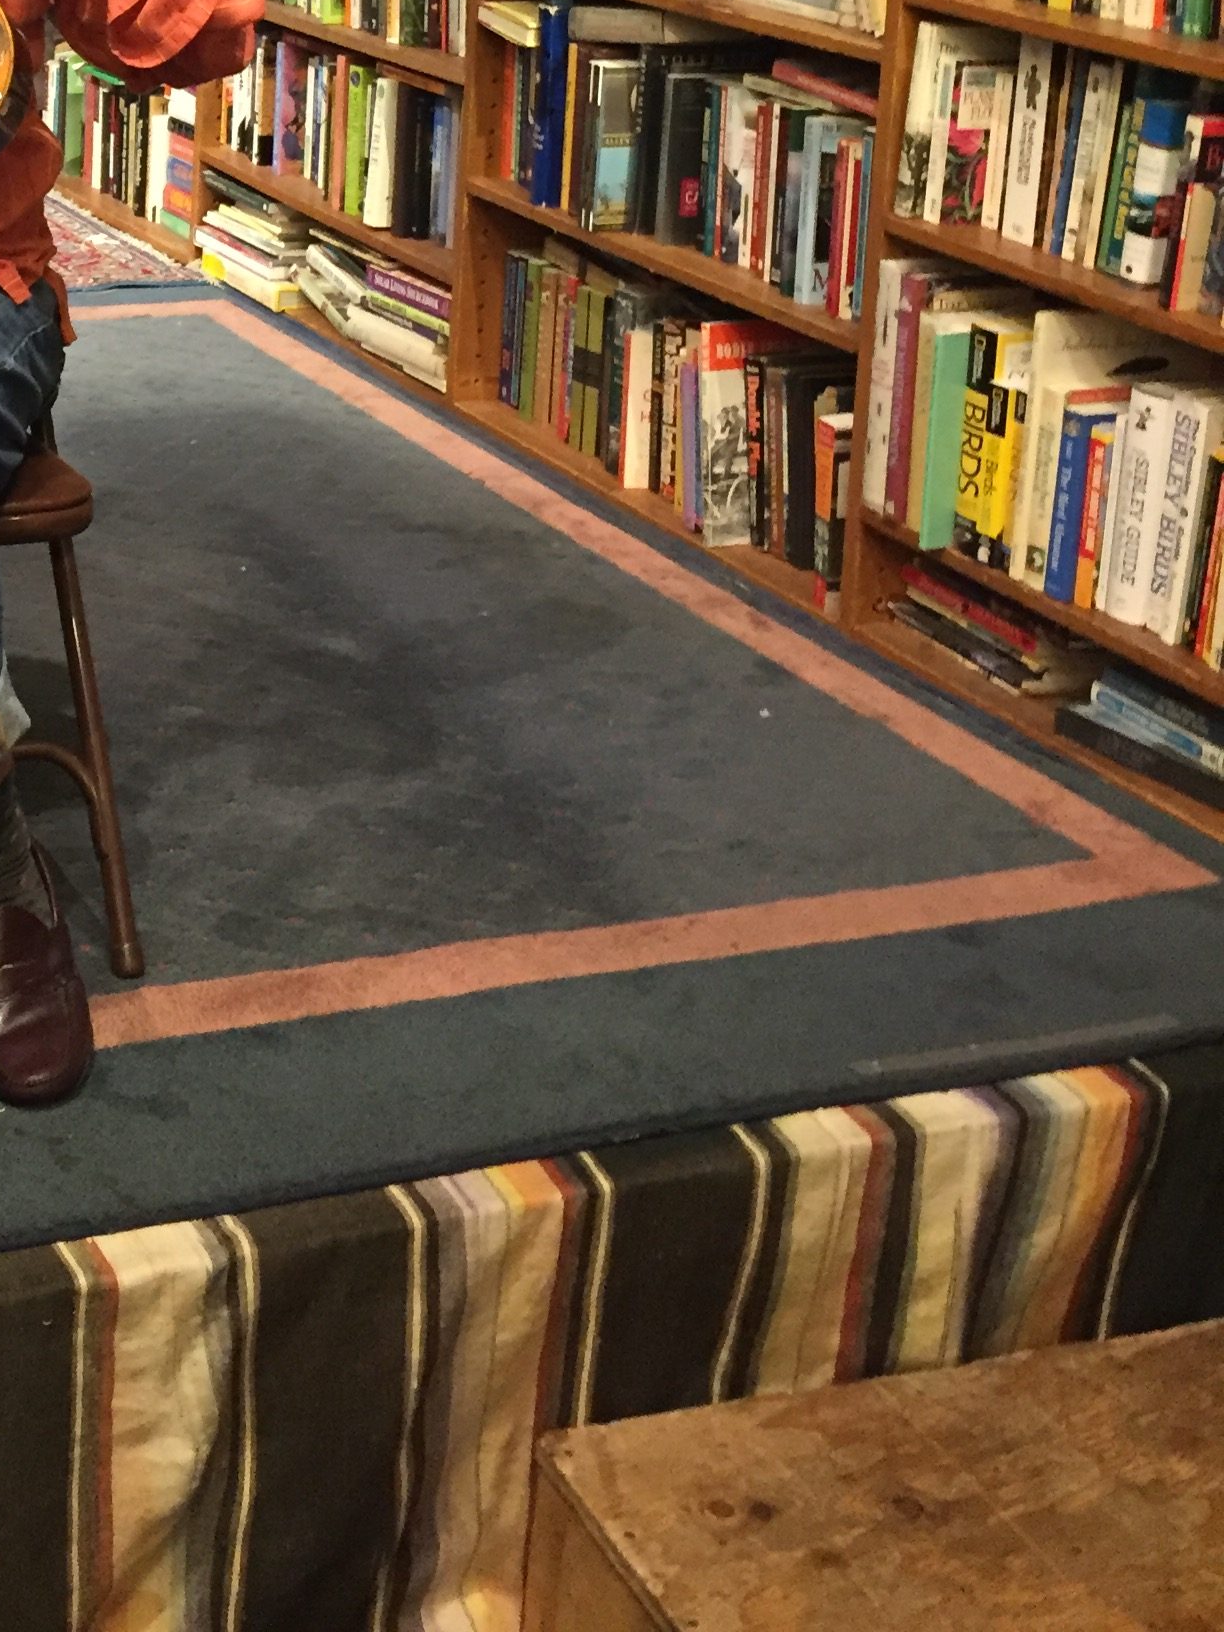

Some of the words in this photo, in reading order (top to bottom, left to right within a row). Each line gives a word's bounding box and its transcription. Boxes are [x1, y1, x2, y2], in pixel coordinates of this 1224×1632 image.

[959, 401, 987, 498] BIRDS
[1129, 456, 1151, 522] SIBLEY
[1164, 410, 1192, 506] SIBLEY
[1120, 524, 1144, 588] GUIDE
[1150, 512, 1178, 598] BIRDS
